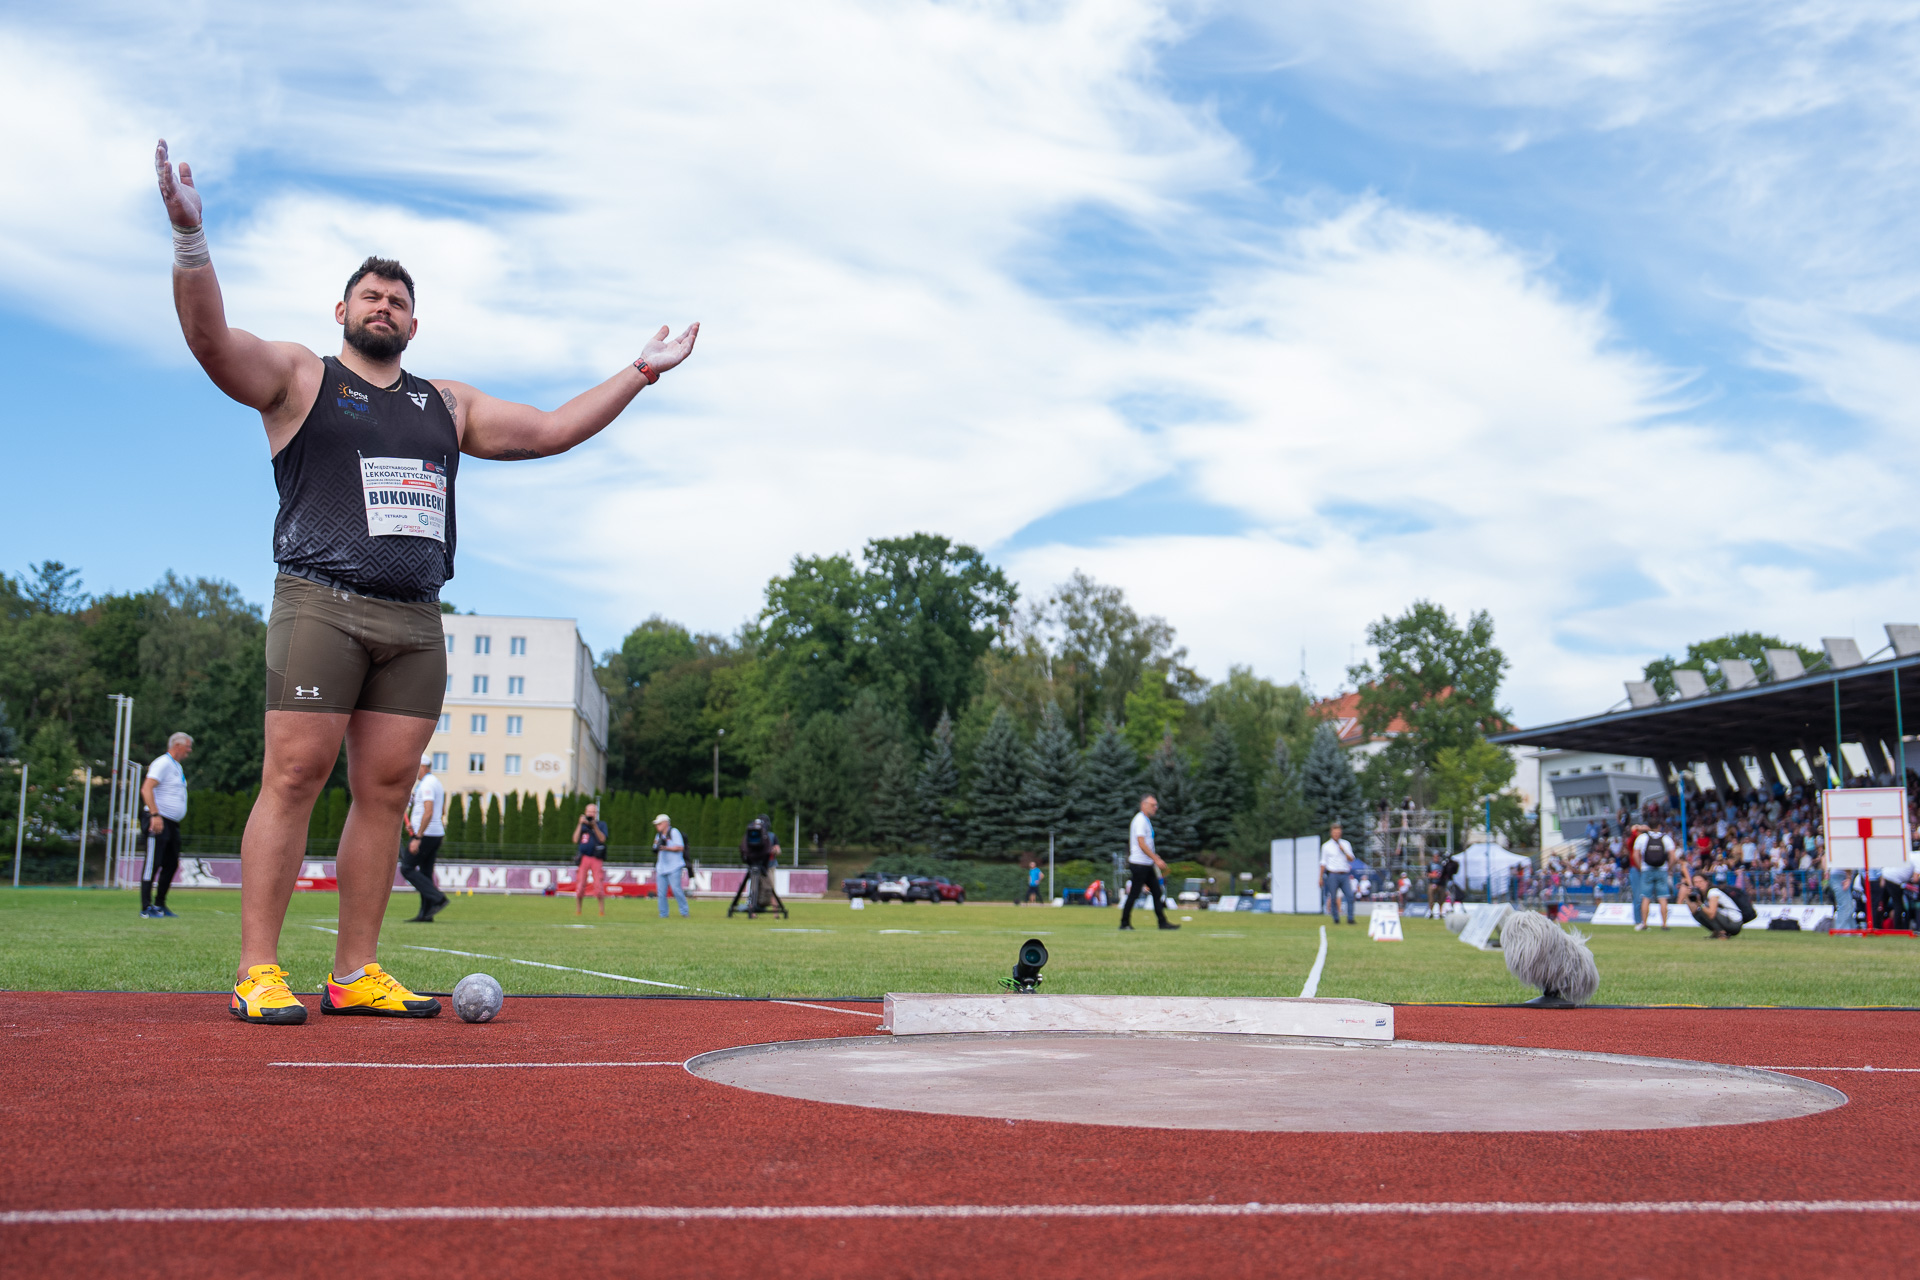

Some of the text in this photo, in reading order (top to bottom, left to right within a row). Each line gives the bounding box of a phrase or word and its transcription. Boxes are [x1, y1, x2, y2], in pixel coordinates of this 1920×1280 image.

[364, 462, 375, 470] IV
[365, 471, 432, 480] LEKKOATLETYCZNY
[369, 490, 444, 513] BUKOWIECKI
[1379, 919, 1398, 935] 17
